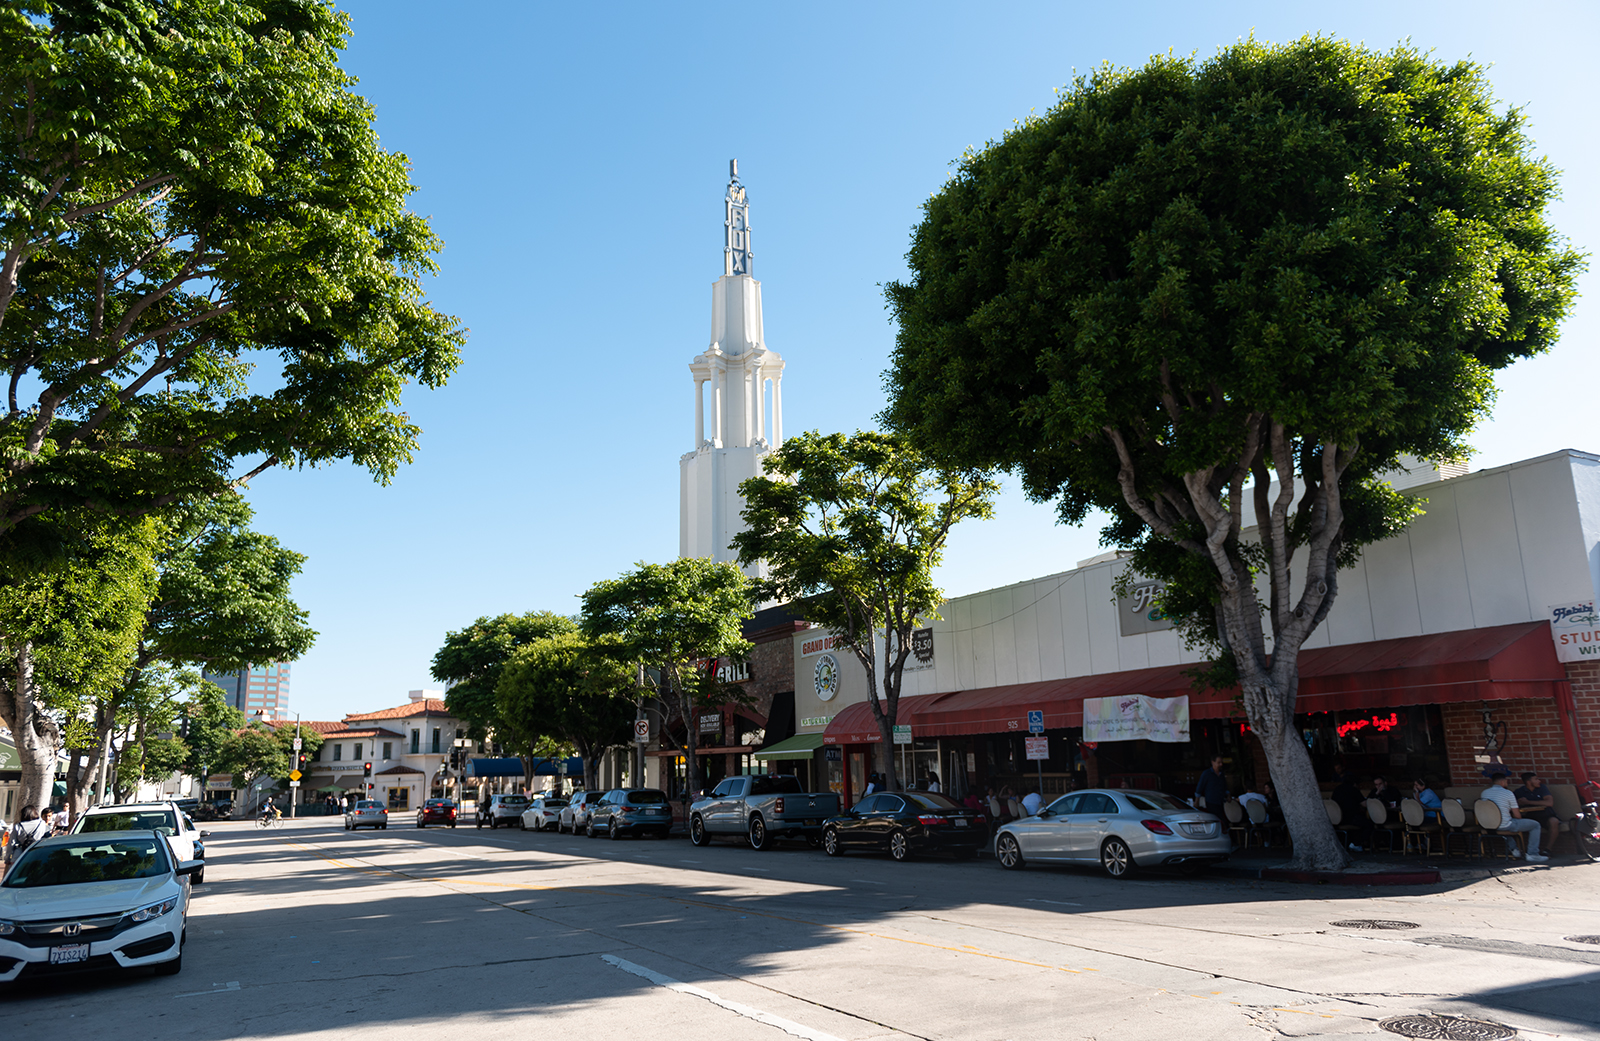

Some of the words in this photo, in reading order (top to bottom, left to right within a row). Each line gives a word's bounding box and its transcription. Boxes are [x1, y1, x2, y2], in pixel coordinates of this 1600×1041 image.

[732, 208, 745, 273] FOX
[1553, 602, 1594, 624] Habibi
[802, 639, 823, 655] GRAND
[914, 639, 932, 651] $3.50
[717, 662, 749, 684] GRILL
[1007, 720, 1019, 729] 925
[825, 750, 842, 760] ATM
[52, 950, 87, 961] 7XIS214
